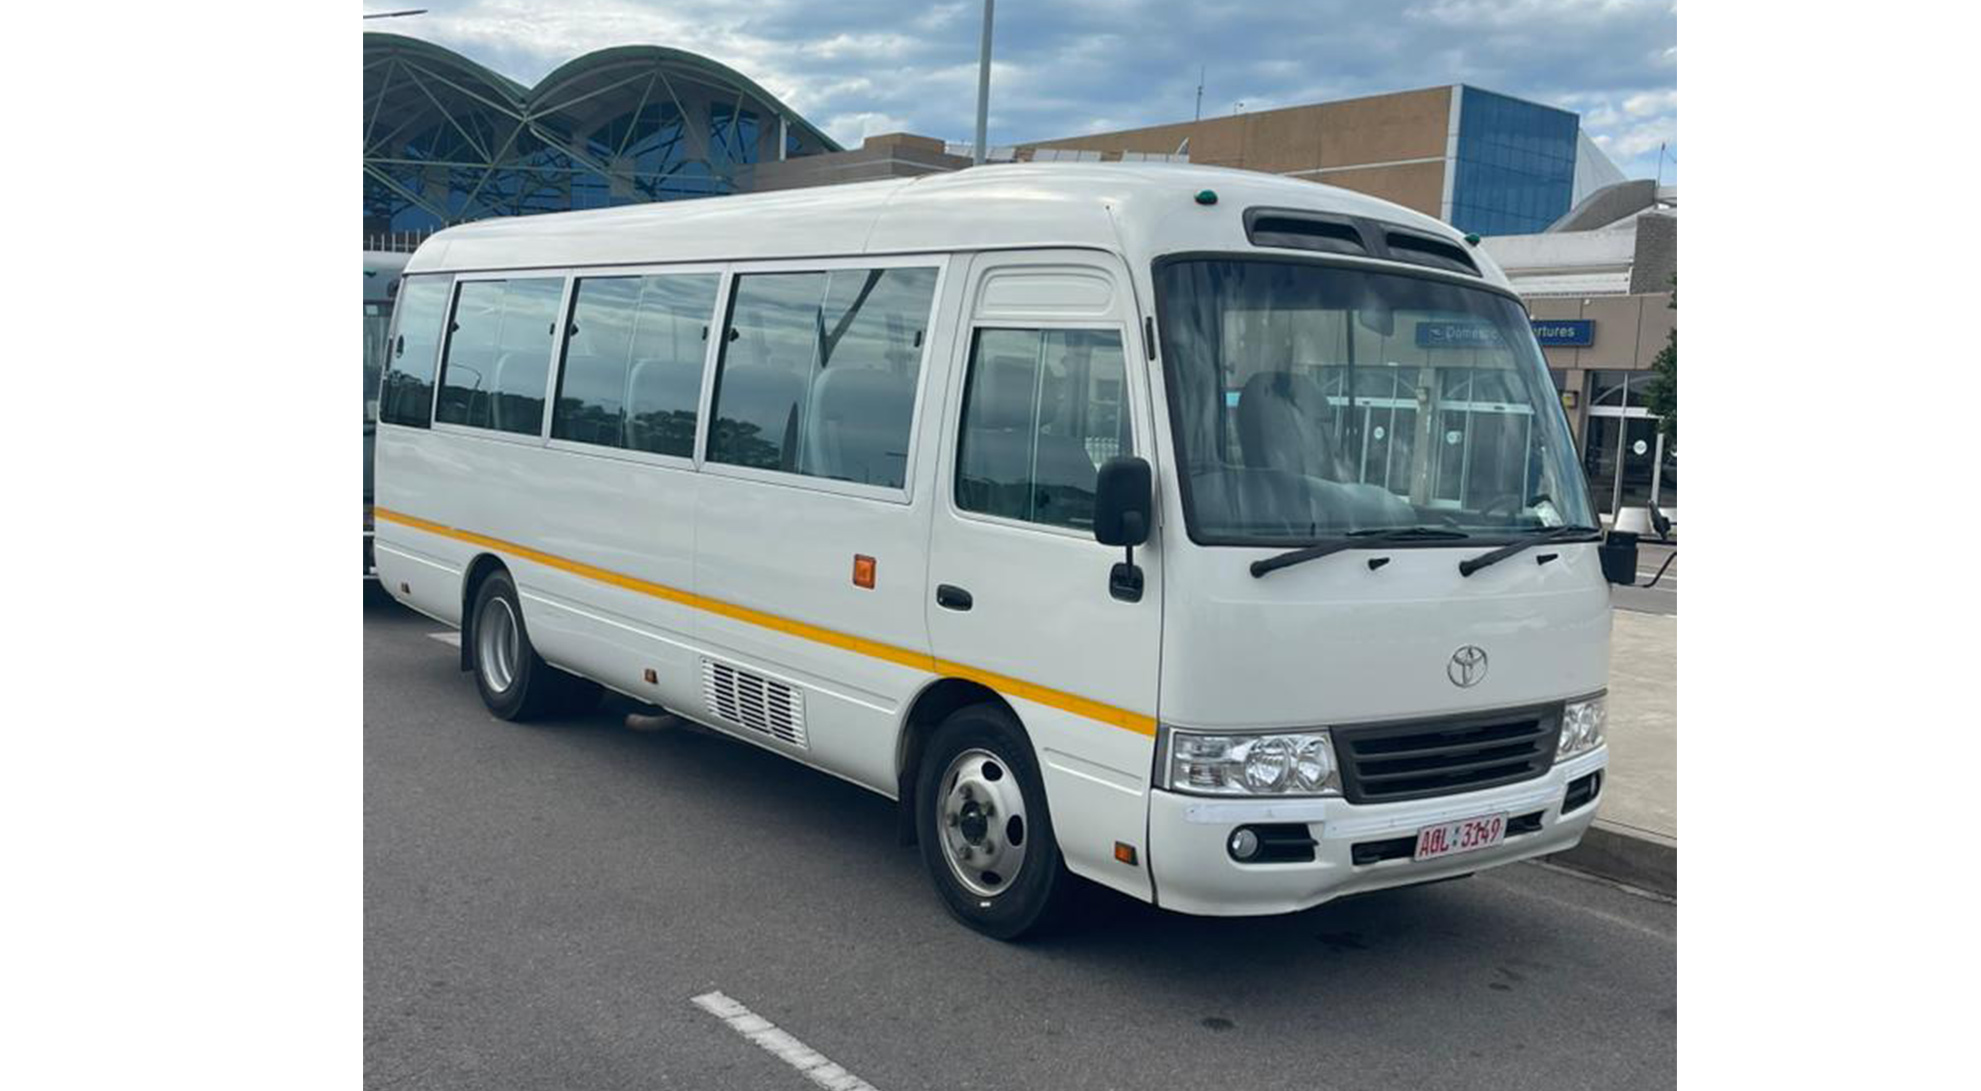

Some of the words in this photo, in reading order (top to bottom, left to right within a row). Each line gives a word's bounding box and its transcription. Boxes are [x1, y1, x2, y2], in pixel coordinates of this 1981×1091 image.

[1445, 326, 1499, 340] Domesc
[1534, 326, 1576, 338] rtures
[1461, 817, 1501, 848] 3149
